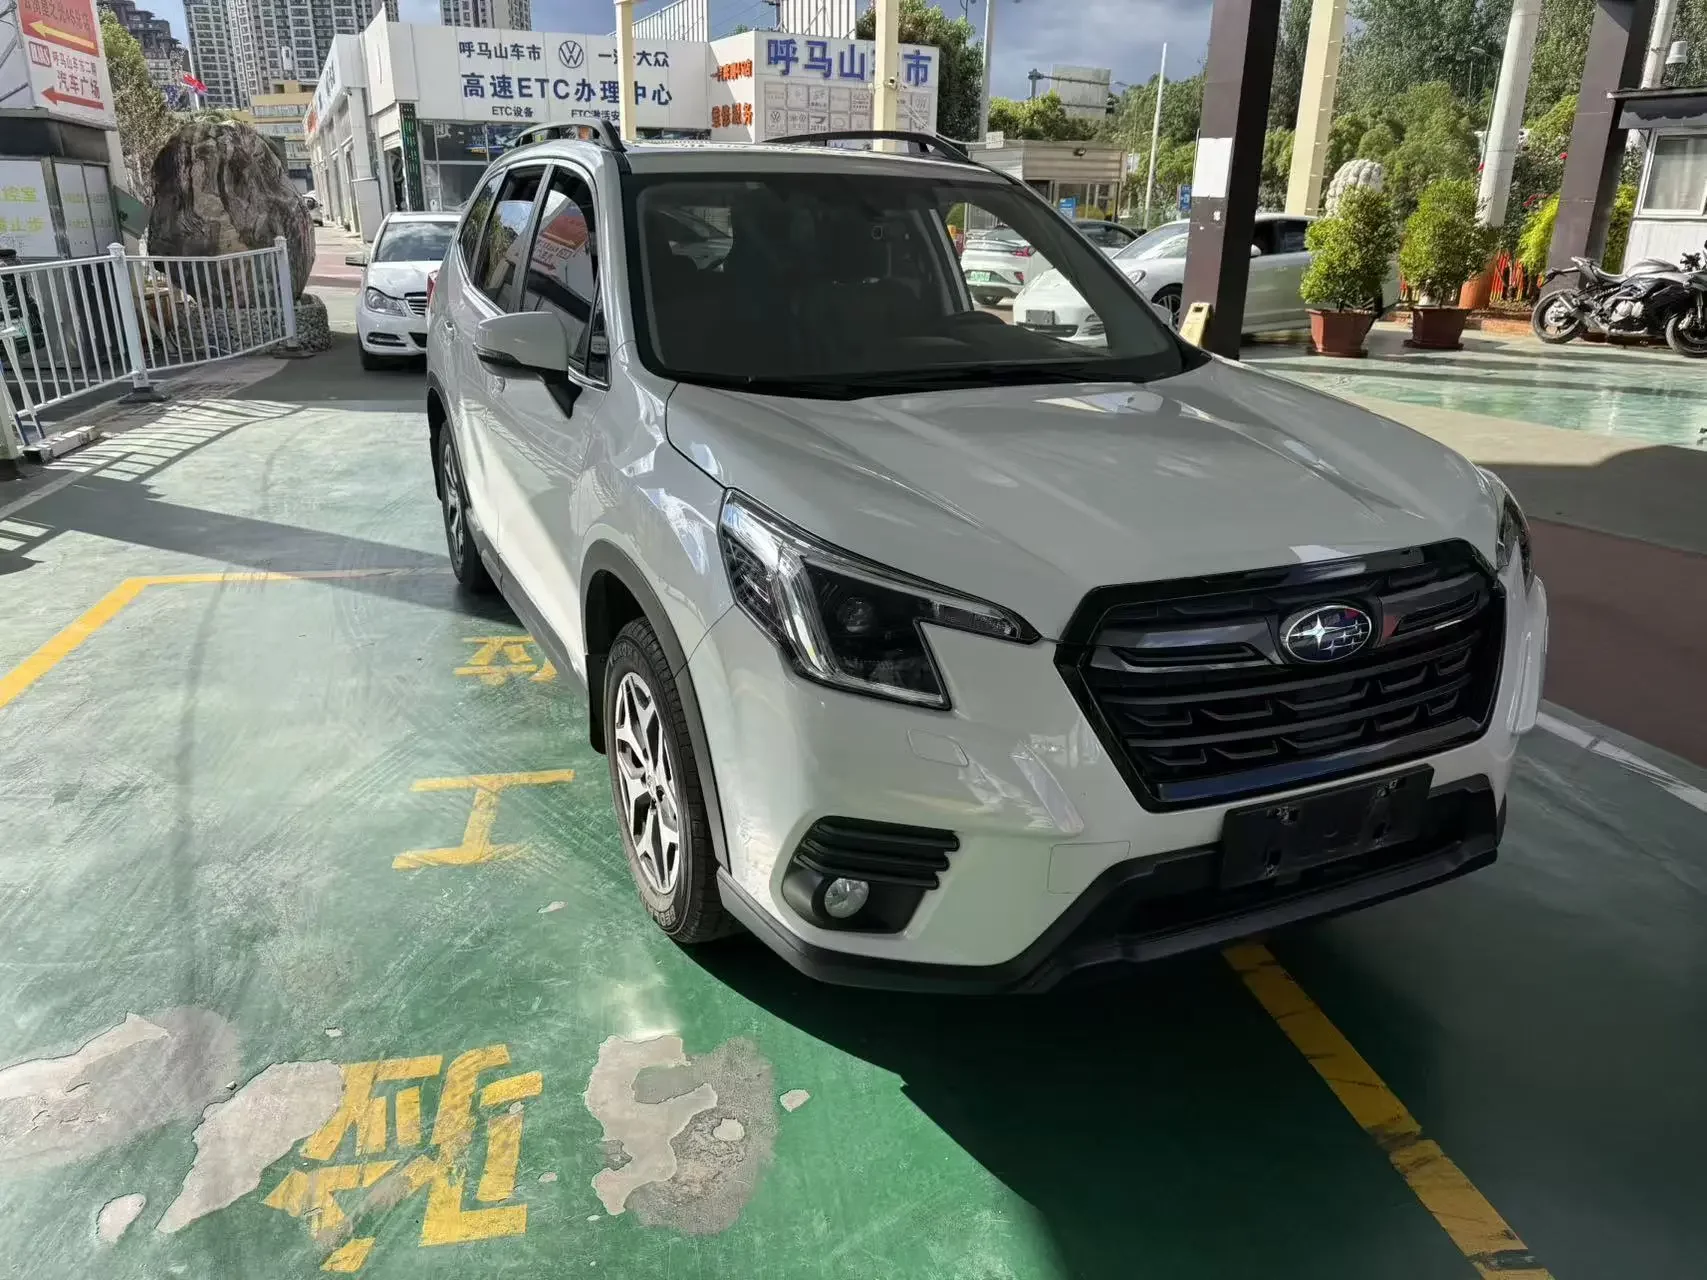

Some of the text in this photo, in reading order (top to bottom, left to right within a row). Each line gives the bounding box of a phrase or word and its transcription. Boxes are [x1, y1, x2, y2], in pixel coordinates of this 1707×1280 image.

[459, 41, 542, 61] 呼马山车市
[767, 38, 932, 87] 呼马山市
[461, 72, 673, 106] 高速ETC办理中心
[491, 105, 534, 118] ETC设备
